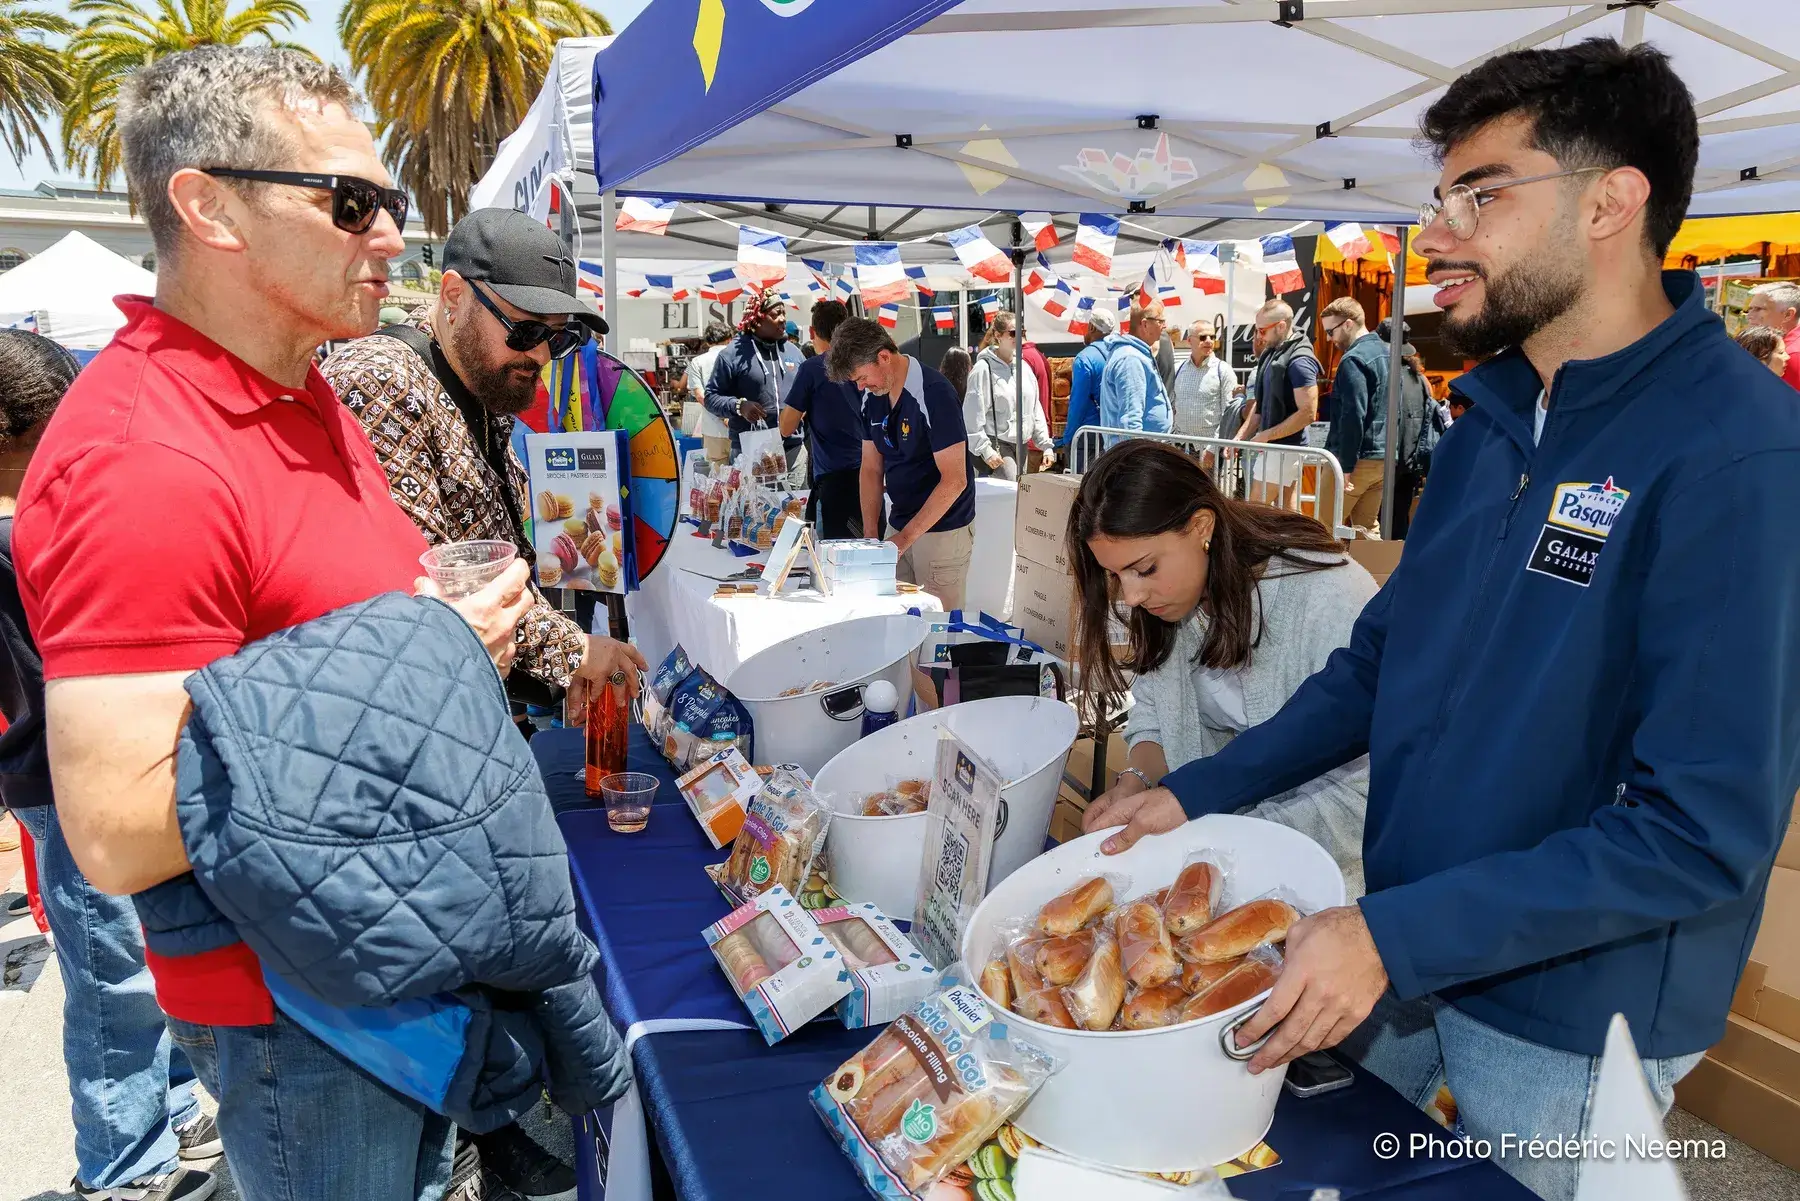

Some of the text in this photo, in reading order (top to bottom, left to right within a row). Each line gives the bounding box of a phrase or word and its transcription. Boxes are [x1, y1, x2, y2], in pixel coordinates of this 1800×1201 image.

[662, 300, 746, 331] EL SU
[1020, 484, 1031, 493] HAUT
[1035, 507, 1048, 517] FRAGILE
[1559, 493, 1617, 527] Pasqui
[1056, 555, 1065, 566] BAS
[1544, 556, 1594, 574] DESSERT
[1548, 540, 1599, 565] GALAX
[1055, 641, 1066, 653] BAS
[678, 693, 688, 704] 8
[943, 779, 961, 809] SCAN
[962, 798, 980, 829] HERE
[756, 864, 767, 874] NO
[923, 908, 959, 962] INFORMATION
[941, 912, 957, 940] MORE
[948, 990, 982, 1024] Pasquier
[895, 1019, 948, 1084] Chocolate Filling
[942, 1028, 963, 1055] To
[956, 1052, 987, 1091] Go!
[914, 1115, 931, 1132] NO
